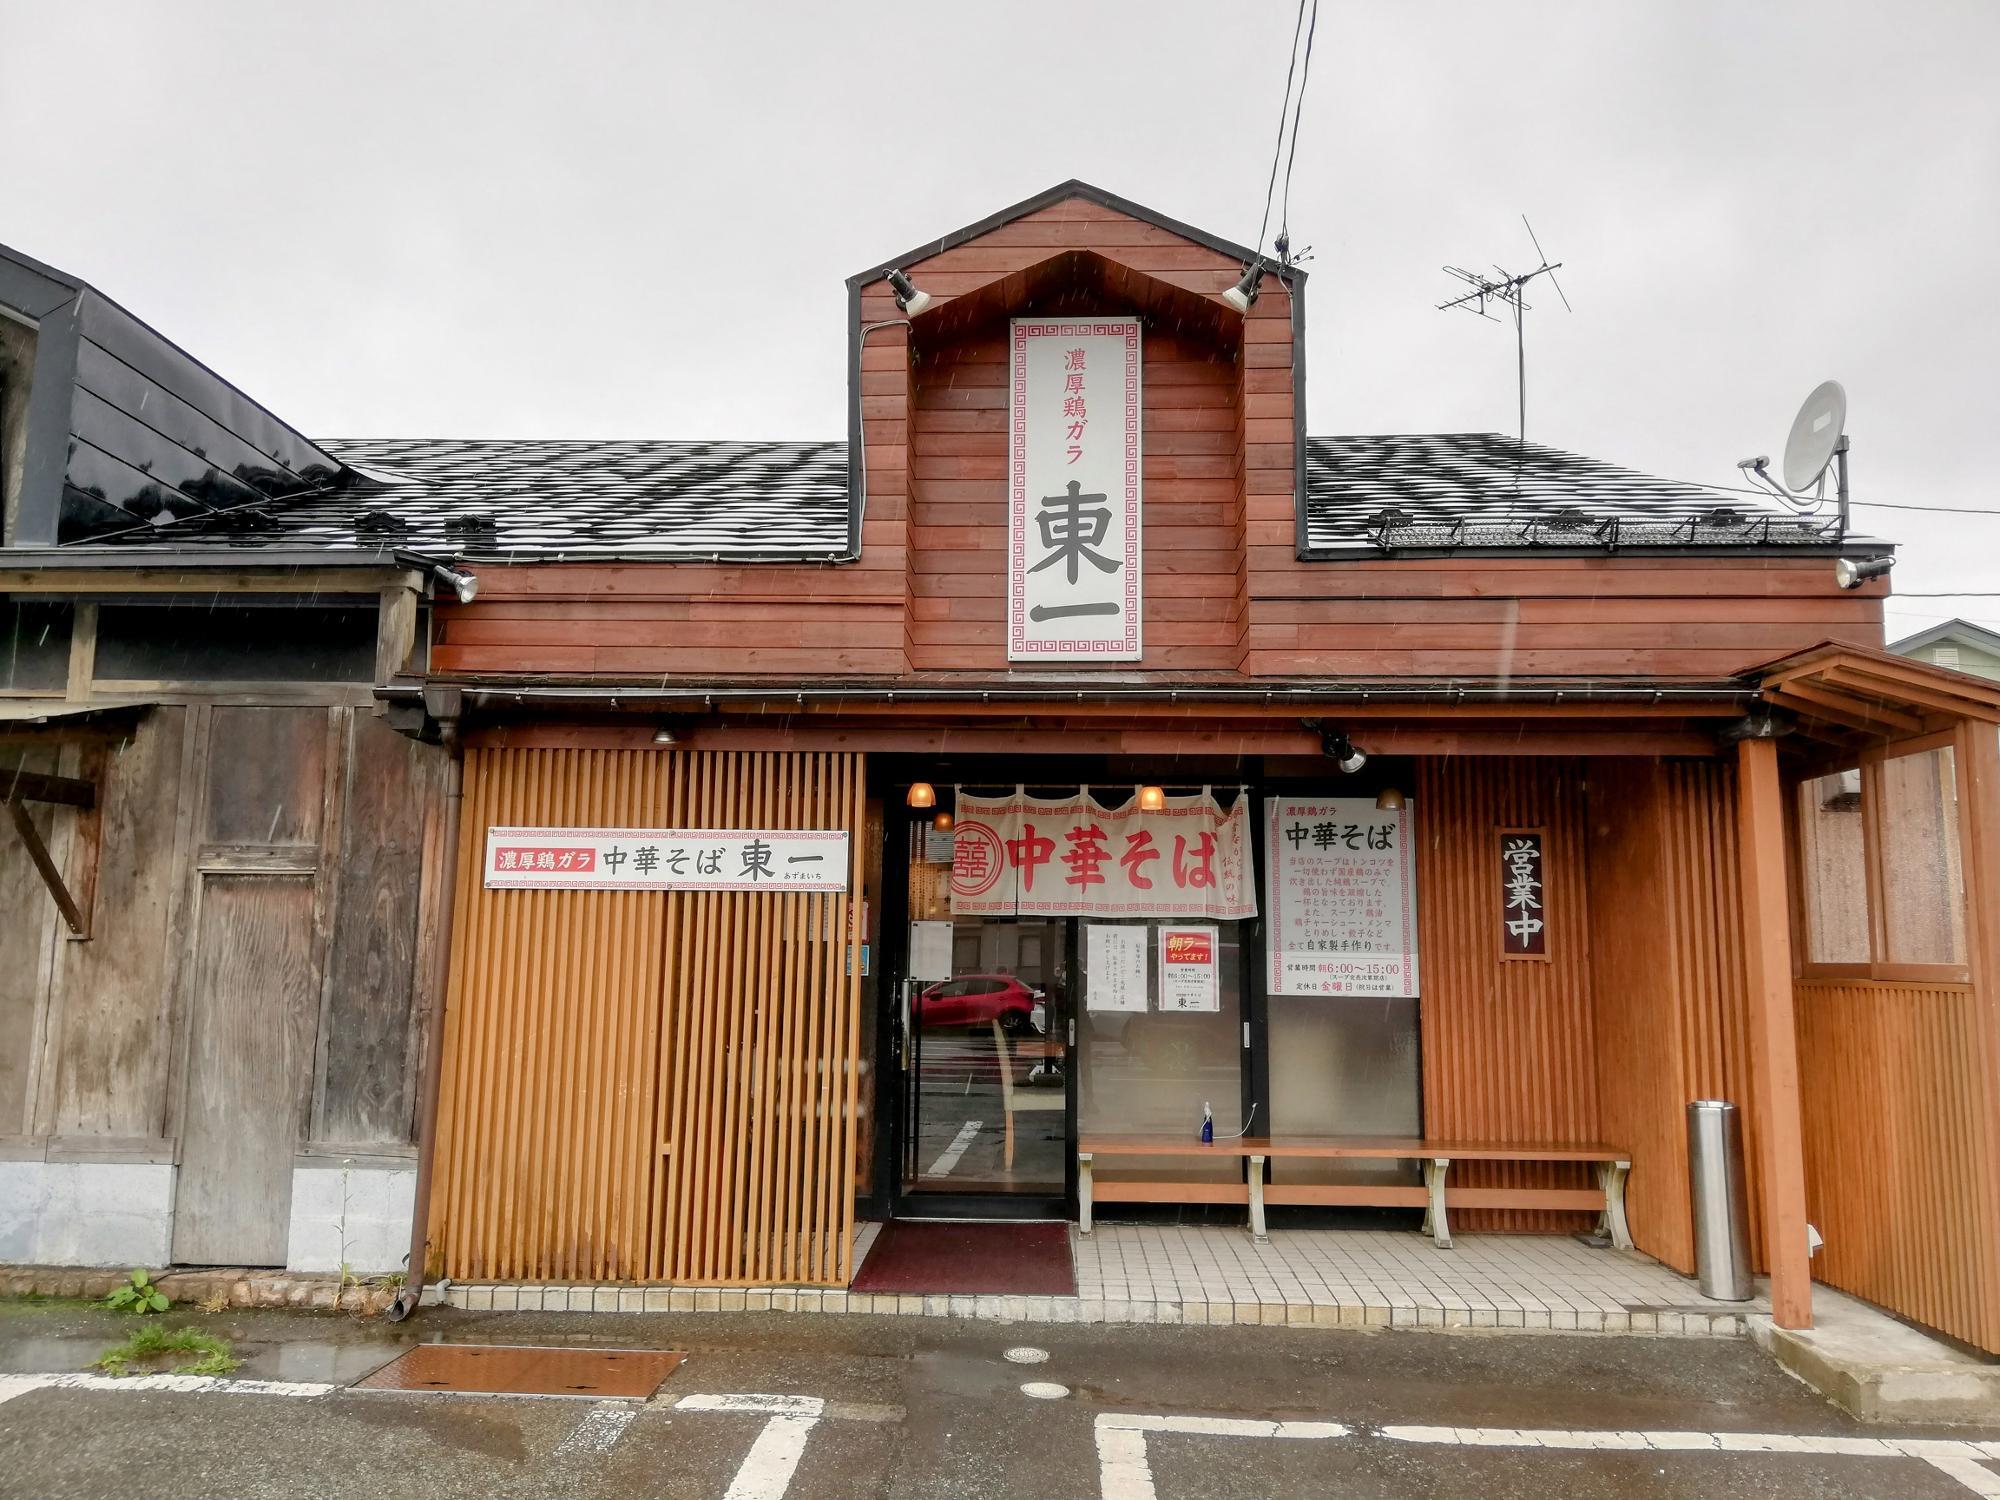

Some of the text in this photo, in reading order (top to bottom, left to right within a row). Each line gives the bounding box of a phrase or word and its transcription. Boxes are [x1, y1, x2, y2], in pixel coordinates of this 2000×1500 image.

[1063, 348, 1088, 465] 濃厚鶏ガラ
[1026, 480, 1123, 622] 東一
[1286, 806, 1337, 816] 濃厚鶏ガラ
[1285, 821, 1396, 851] 中華そば
[498, 839, 824, 881] 濃厚鶏ガラ 中華そば 東一
[1005, 823, 1218, 894] 中華そば
[784, 871, 822, 880] あずまいち
[1503, 839, 1543, 948] 営業中
[1168, 935, 1208, 951] 朝ラー
[1286, 964, 1316, 972] 営業時間
[1296, 982, 1317, 990] 定休日
[1321, 981, 1353, 991] 金曜日
